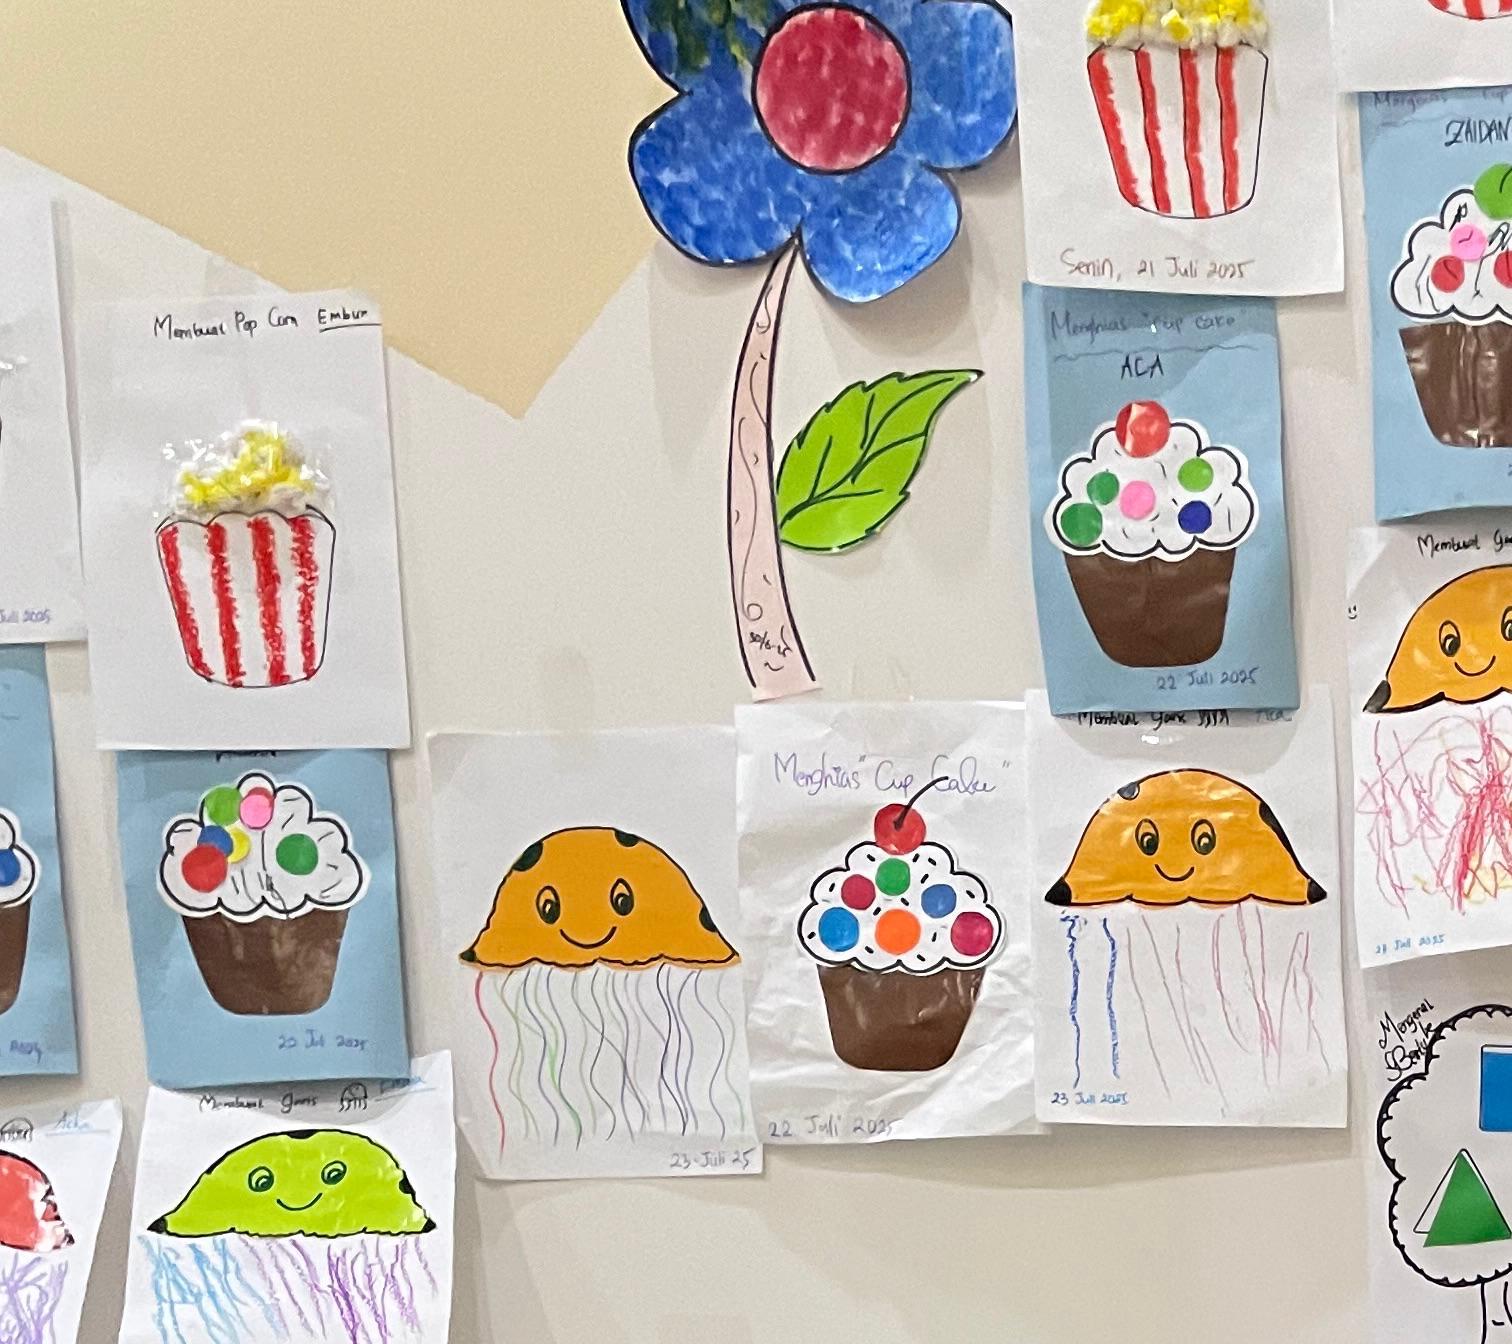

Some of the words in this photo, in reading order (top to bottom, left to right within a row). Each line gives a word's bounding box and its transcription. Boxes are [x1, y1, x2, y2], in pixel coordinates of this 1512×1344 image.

[1060, 248, 1121, 282] Senin,
[1137, 259, 1154, 277] 21
[1165, 256, 1199, 278] Juli
[1206, 259, 1255, 279] 2025
[235, 310, 258, 338] Pop
[1120, 353, 1165, 380] ACA
[1156, 676, 1177, 691] 22
[1219, 666, 1260, 685] 2025
[1050, 1091, 1069, 1107] 23
[769, 1122, 793, 1138] 22
